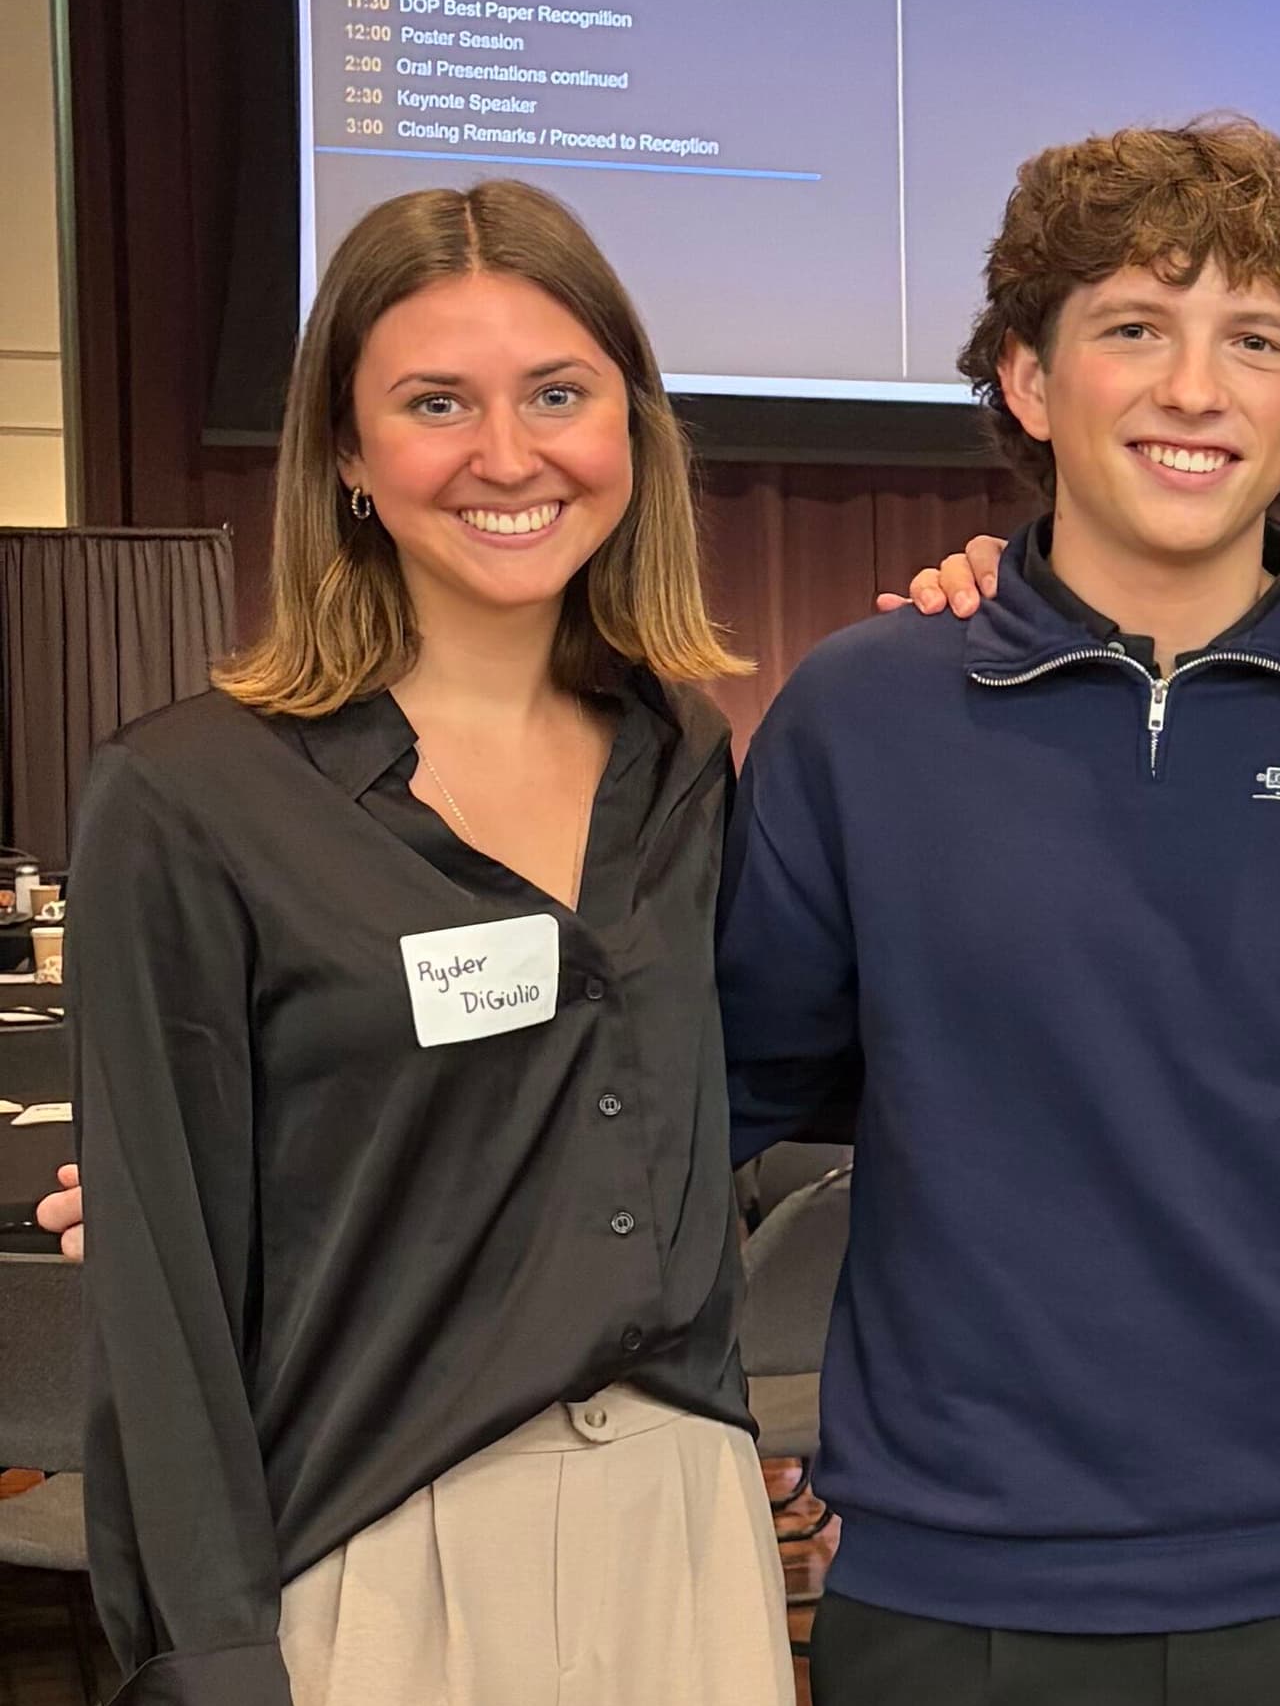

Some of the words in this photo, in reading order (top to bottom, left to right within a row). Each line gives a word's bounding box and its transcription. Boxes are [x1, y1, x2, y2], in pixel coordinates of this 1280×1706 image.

[443, 0, 481, 18] Best
[485, 2, 534, 24] Paper
[538, 6, 632, 29] Recognition
[345, 24, 391, 42] 12:00
[401, 27, 455, 46] Poster
[459, 31, 524, 51] Session
[345, 56, 382, 73] 2:00
[396, 57, 432, 77] Oral
[437, 60, 546, 84] Presentations
[551, 70, 629, 89] continued
[345, 87, 383, 105] 2:30
[398, 89, 465, 111] Keynote
[469, 93, 537, 115] Speaker
[345, 118, 383, 135] 3:00
[398, 121, 459, 143] Closing
[464, 125, 536, 144] Remarks
[540, 129, 547, 145] /
[551, 129, 615, 149] Proceed
[620, 134, 636, 150] to
[640, 135, 719, 157] Reception
[417, 956, 488, 993] Ryder
